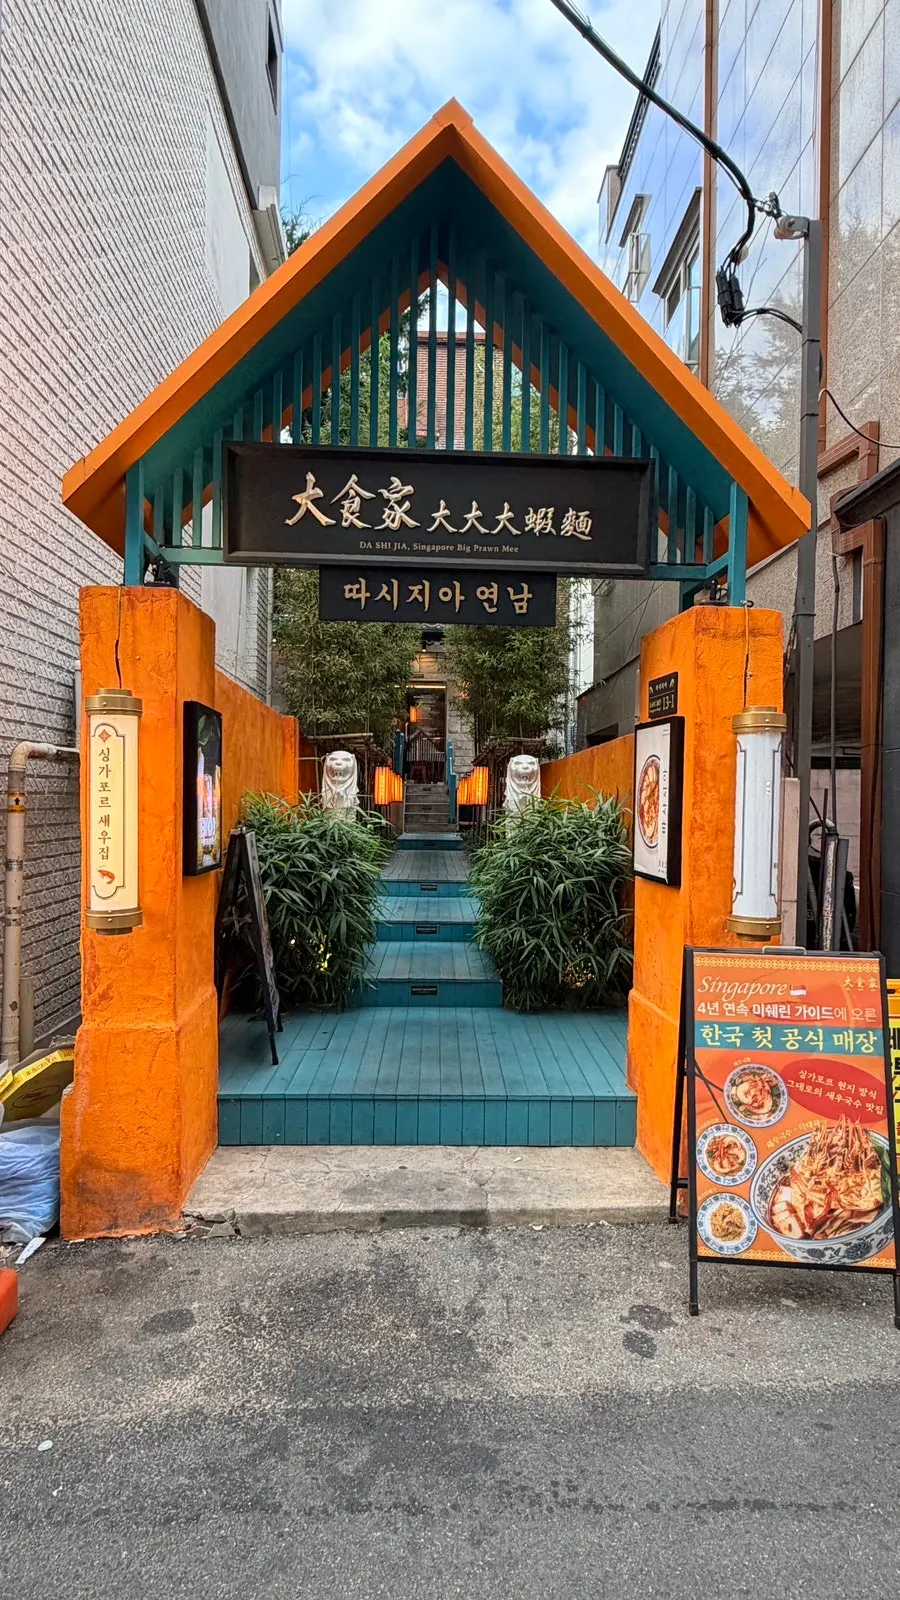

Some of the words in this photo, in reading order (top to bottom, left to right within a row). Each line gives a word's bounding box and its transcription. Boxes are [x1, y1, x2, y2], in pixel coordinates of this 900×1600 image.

[284, 470, 421, 531] 大食家
[427, 499, 593, 541] 大大大蝦麵
[359, 541, 373, 549] DA
[375, 541, 391, 550] SHI
[393, 542, 410, 551] JIA,
[413, 543, 455, 553] Singapore
[457, 543, 471, 553] Big
[473, 544, 499, 552] Prawn
[501, 545, 519, 553] Mee
[343, 577, 465, 614] 따시지아
[475, 585, 534, 614] 연남
[697, 975, 788, 1001] Singapore
[697, 1003, 720, 1016] 4년
[722, 1003, 750, 1017] 연속
[752, 1004, 791, 1019] 미쉐린
[794, 1005, 847, 1021] 가이드에
[851, 1008, 878, 1023] 오른
[700, 1023, 745, 1047] 한국
[751, 1026, 773, 1049] 첫
[780, 1028, 825, 1052] 공식
[832, 1029, 877, 1053] 매장
[786, 1079, 823, 1098] 그대로의
[825, 1091, 862, 1108] 새우국수
[865, 1102, 884, 1116] 맛집
[798, 1069, 834, 1087] 싱가포르
[838, 1081, 856, 1094] 현지
[858, 1087, 877, 1100] 방식
